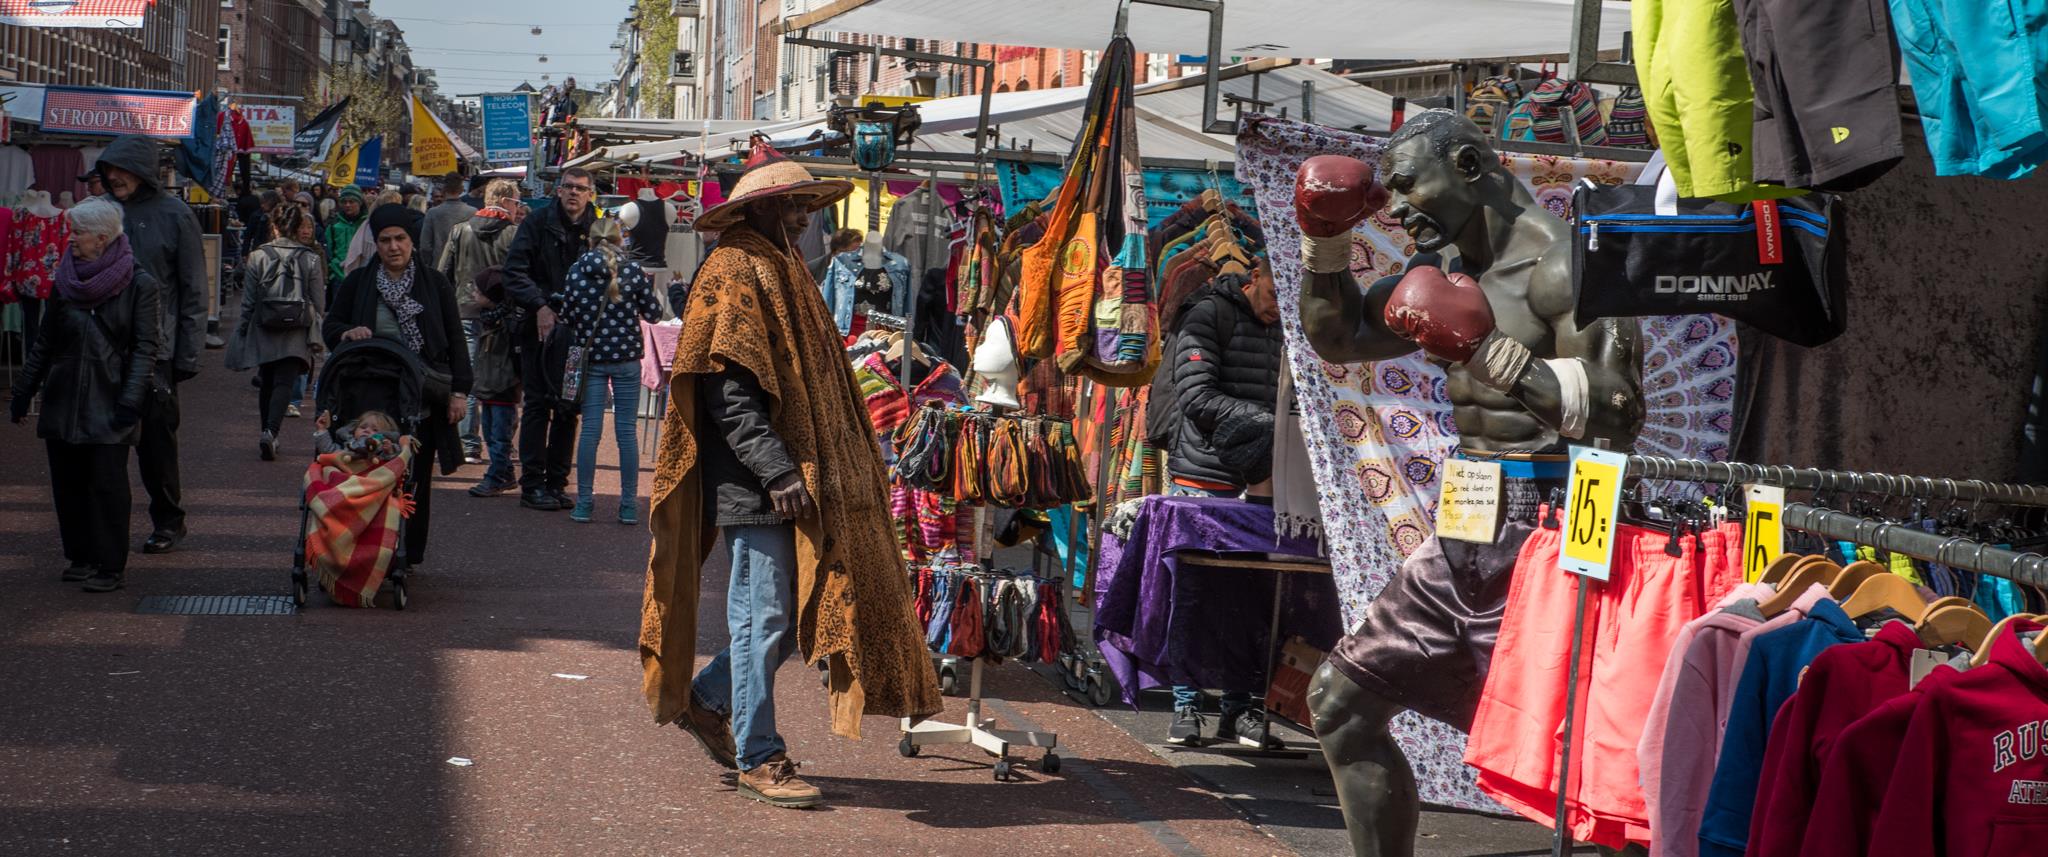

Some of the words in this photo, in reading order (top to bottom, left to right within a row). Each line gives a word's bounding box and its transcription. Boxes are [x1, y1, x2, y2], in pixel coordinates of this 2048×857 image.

[50, 107, 188, 131] STROOPWAFELS
[496, 151, 529, 159] Lebara
[1762, 204, 1775, 258] DONNAY
[1697, 293, 1727, 301] SINCE
[1444, 481, 1458, 493] Do
